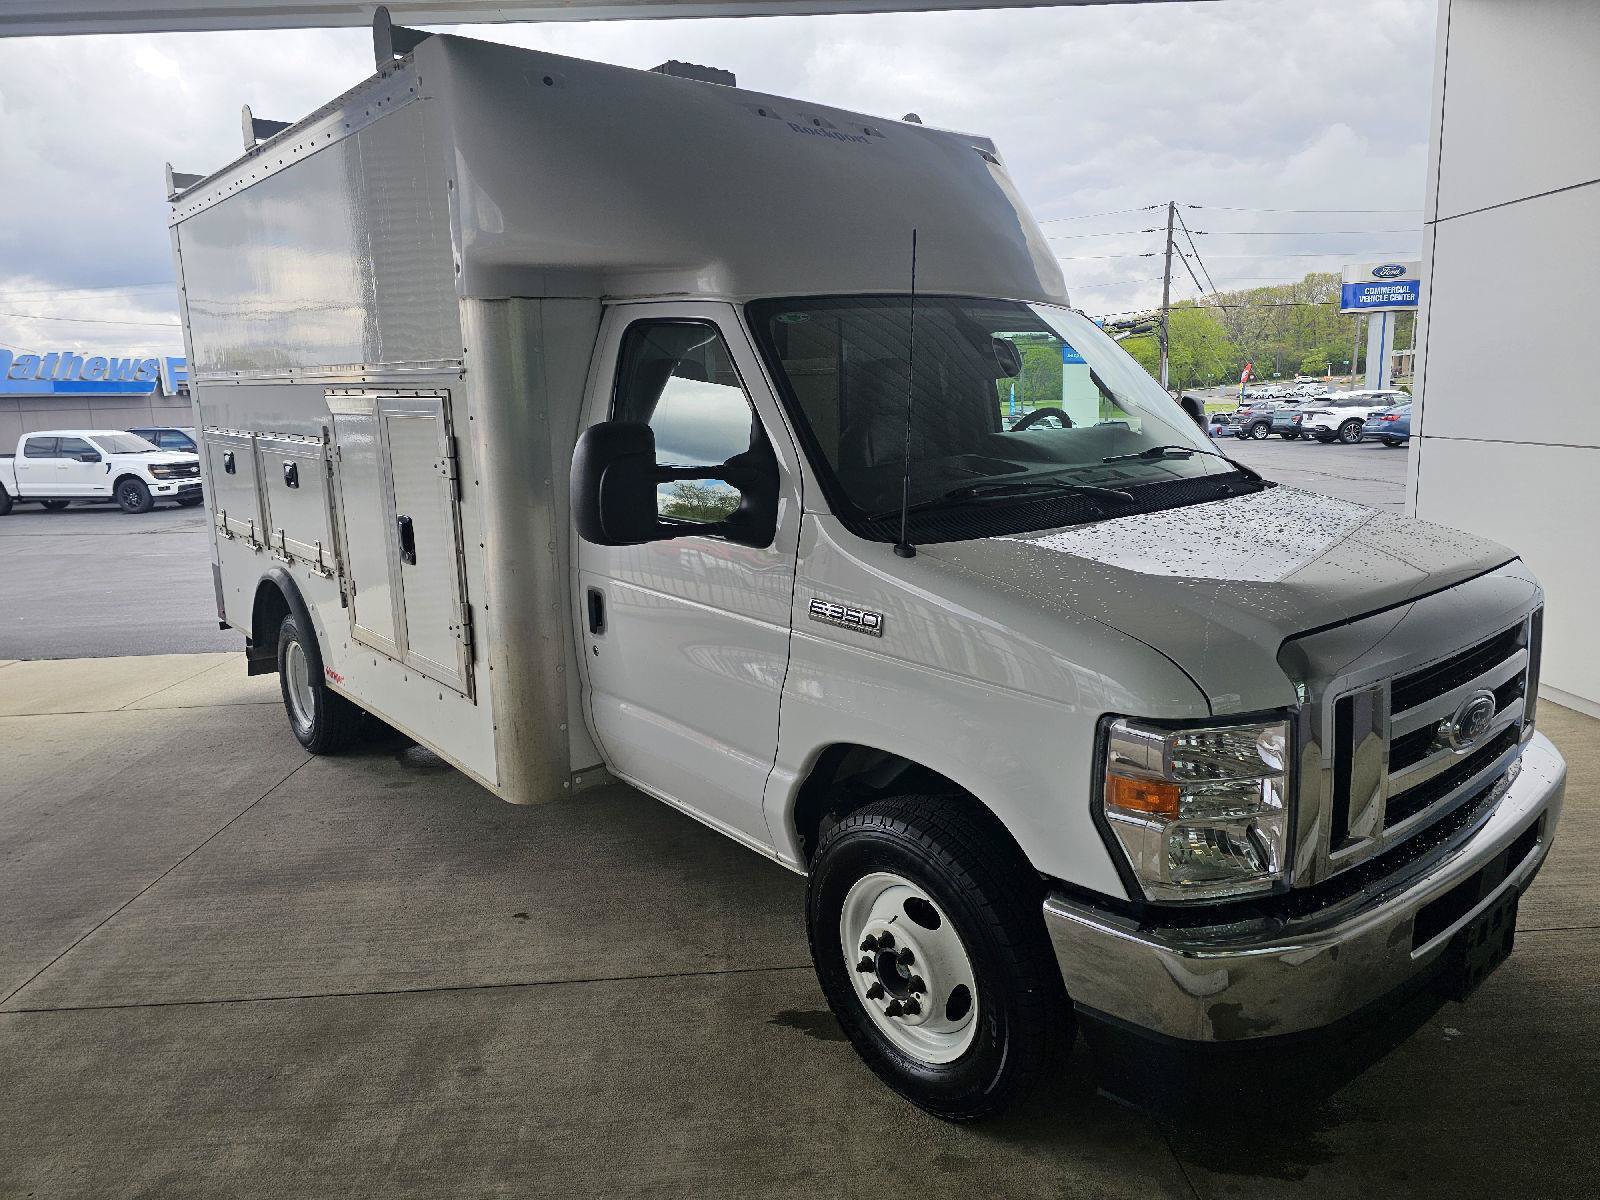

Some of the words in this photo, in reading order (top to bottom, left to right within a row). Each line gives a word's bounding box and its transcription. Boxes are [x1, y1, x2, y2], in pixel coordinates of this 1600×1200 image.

[786, 121, 873, 144] Rockport
[1364, 285, 1411, 295] COMMERCIAL
[1359, 295, 1389, 303] VEHICLE
[1389, 293, 1415, 302] CENTER
